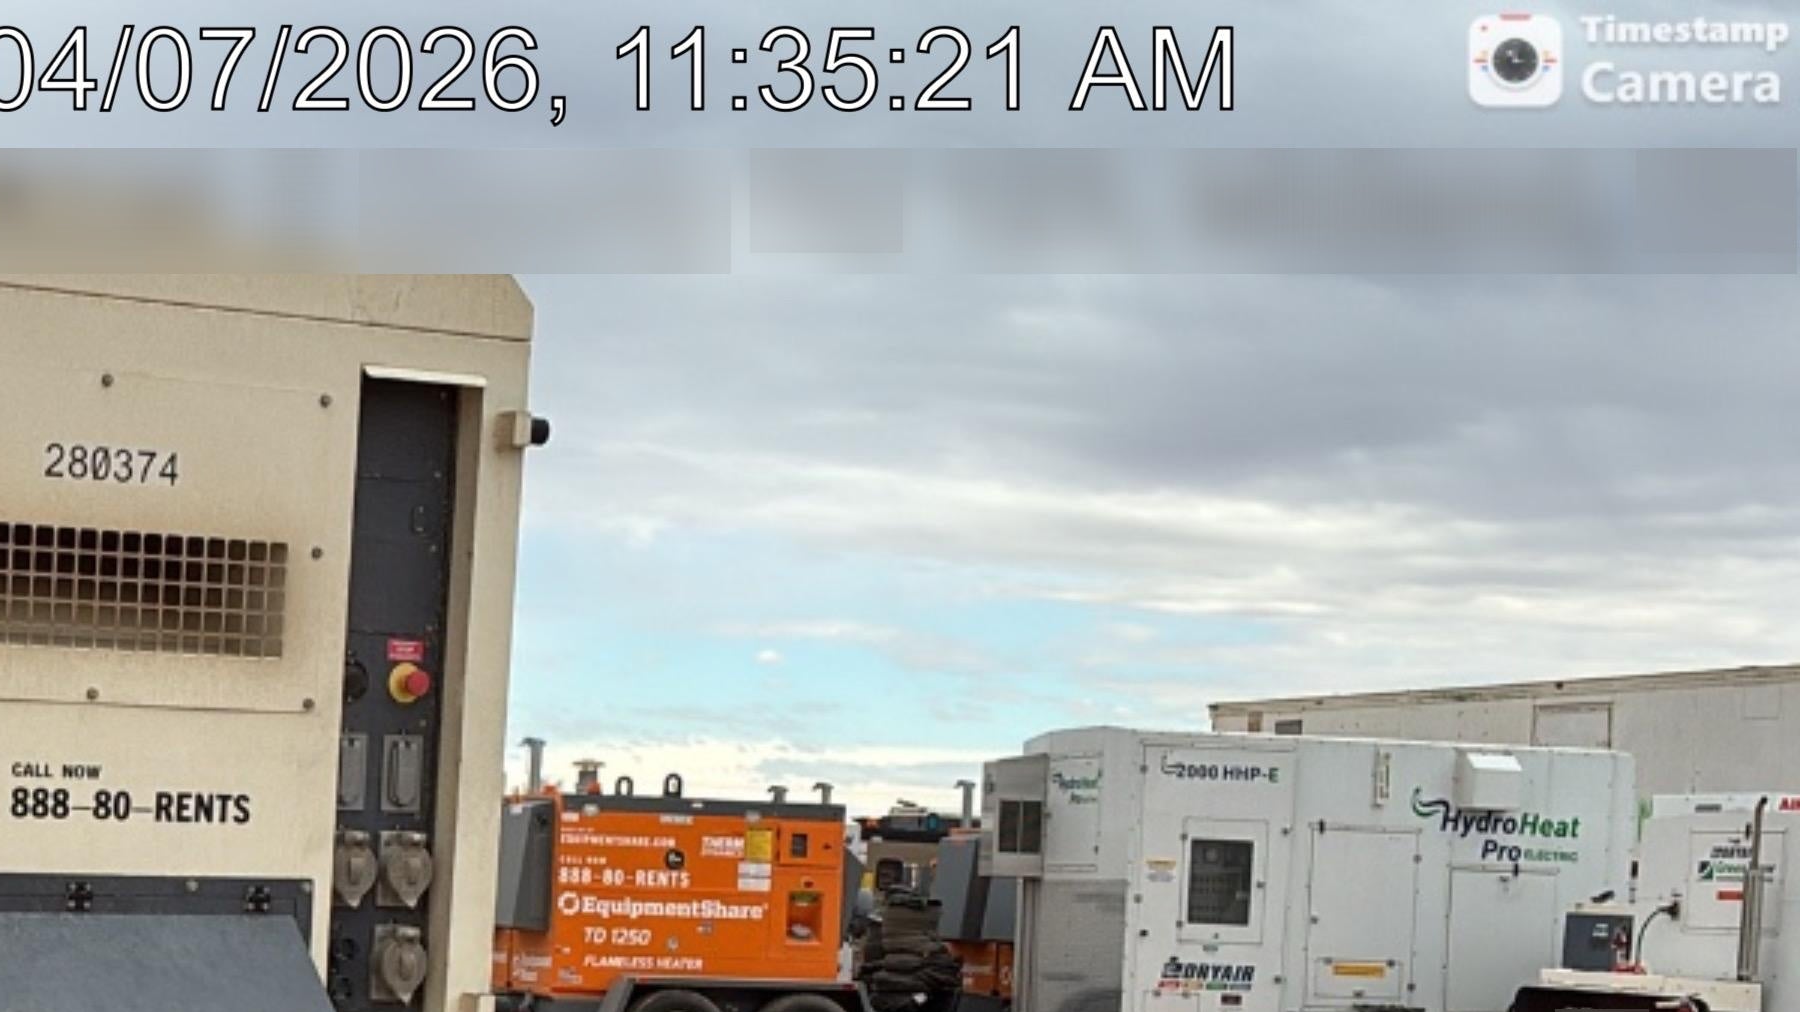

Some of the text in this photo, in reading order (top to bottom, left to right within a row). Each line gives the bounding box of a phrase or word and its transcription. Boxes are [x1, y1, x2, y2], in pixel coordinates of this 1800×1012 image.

[44, 442, 179, 487] 280374
[11, 761, 102, 780] CALL NOW
[1173, 762, 1218, 781] 2000
[1440, 805, 1581, 838] HydroHeat
[1481, 839, 1522, 862] Pro
[581, 896, 763, 920] EquipmentShare
